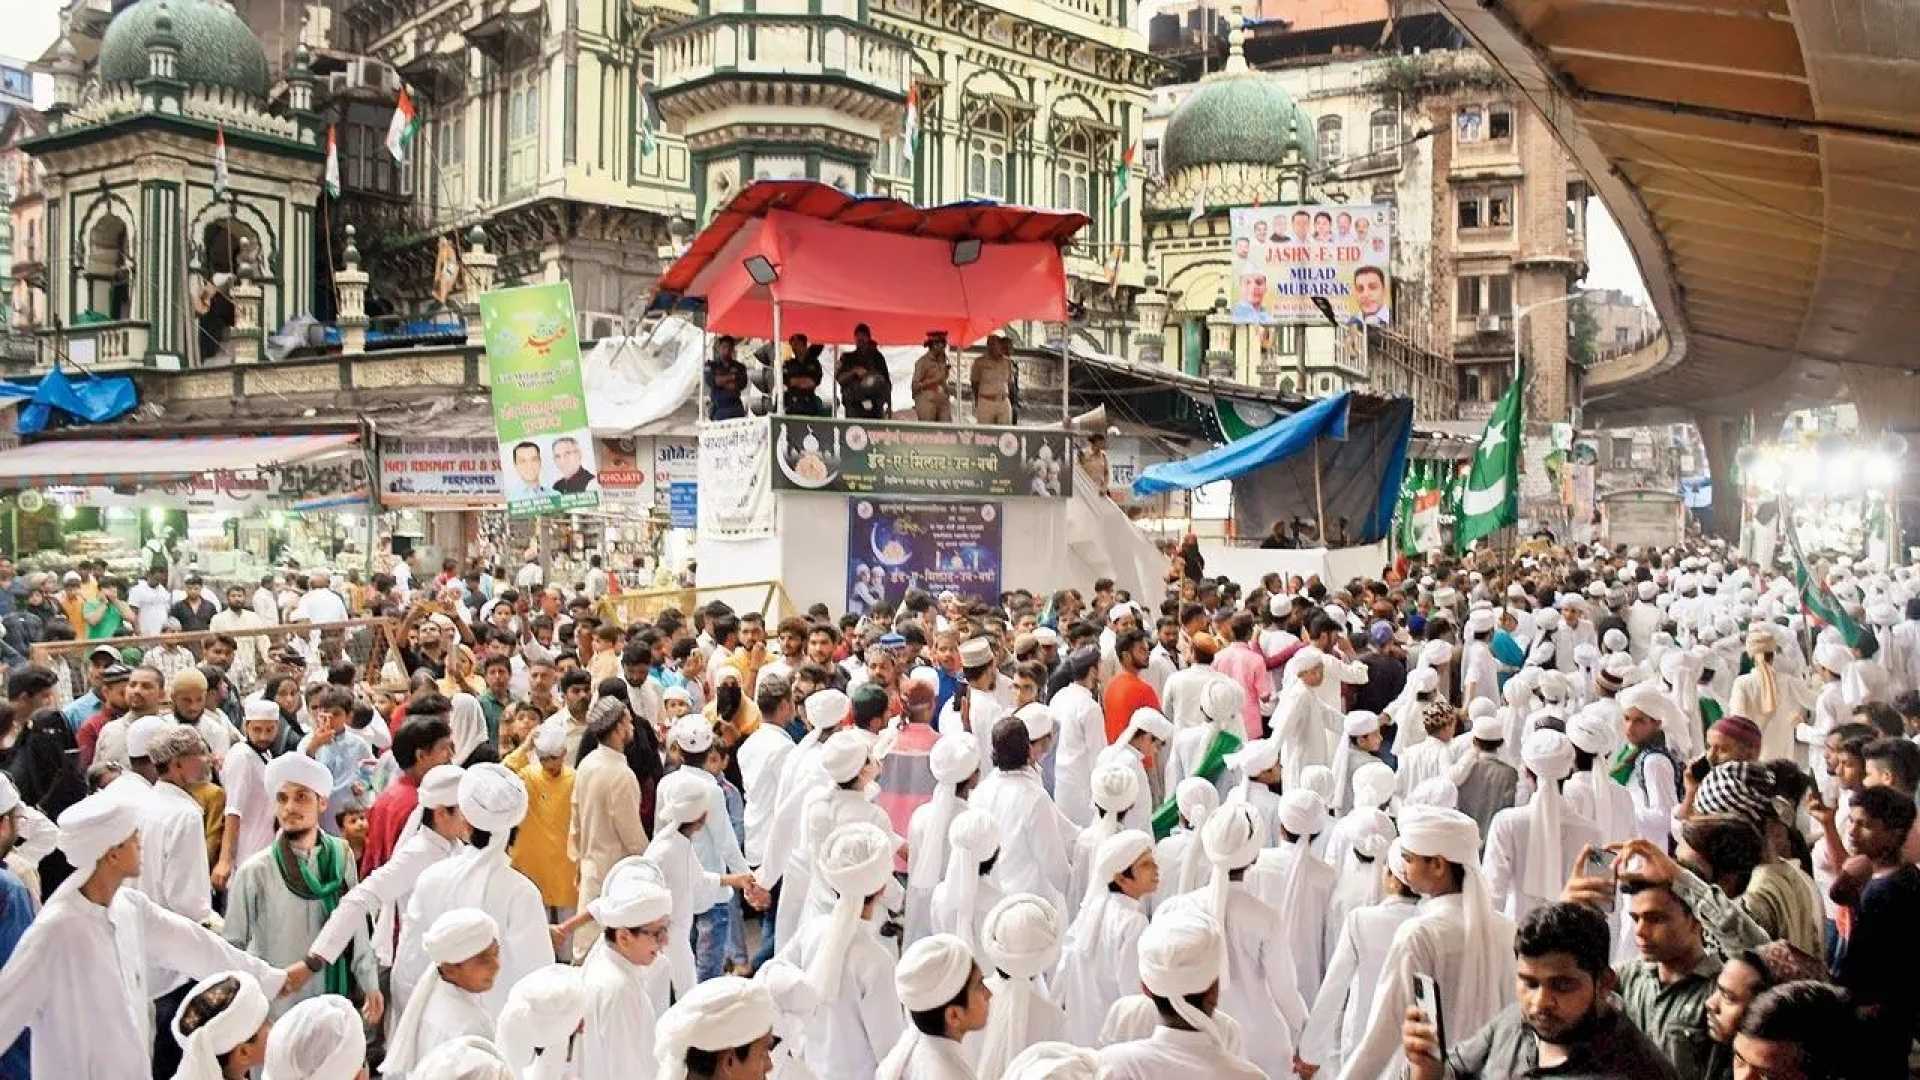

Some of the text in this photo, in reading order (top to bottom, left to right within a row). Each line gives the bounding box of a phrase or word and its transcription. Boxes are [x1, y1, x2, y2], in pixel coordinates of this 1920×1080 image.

[1265, 246, 1311, 263] JASHN
[1337, 246, 1361, 262] EID
[1290, 267, 1336, 280] MILAD
[1277, 282, 1350, 295] MUBARAK
[600, 472, 640, 482] KHOJATI
